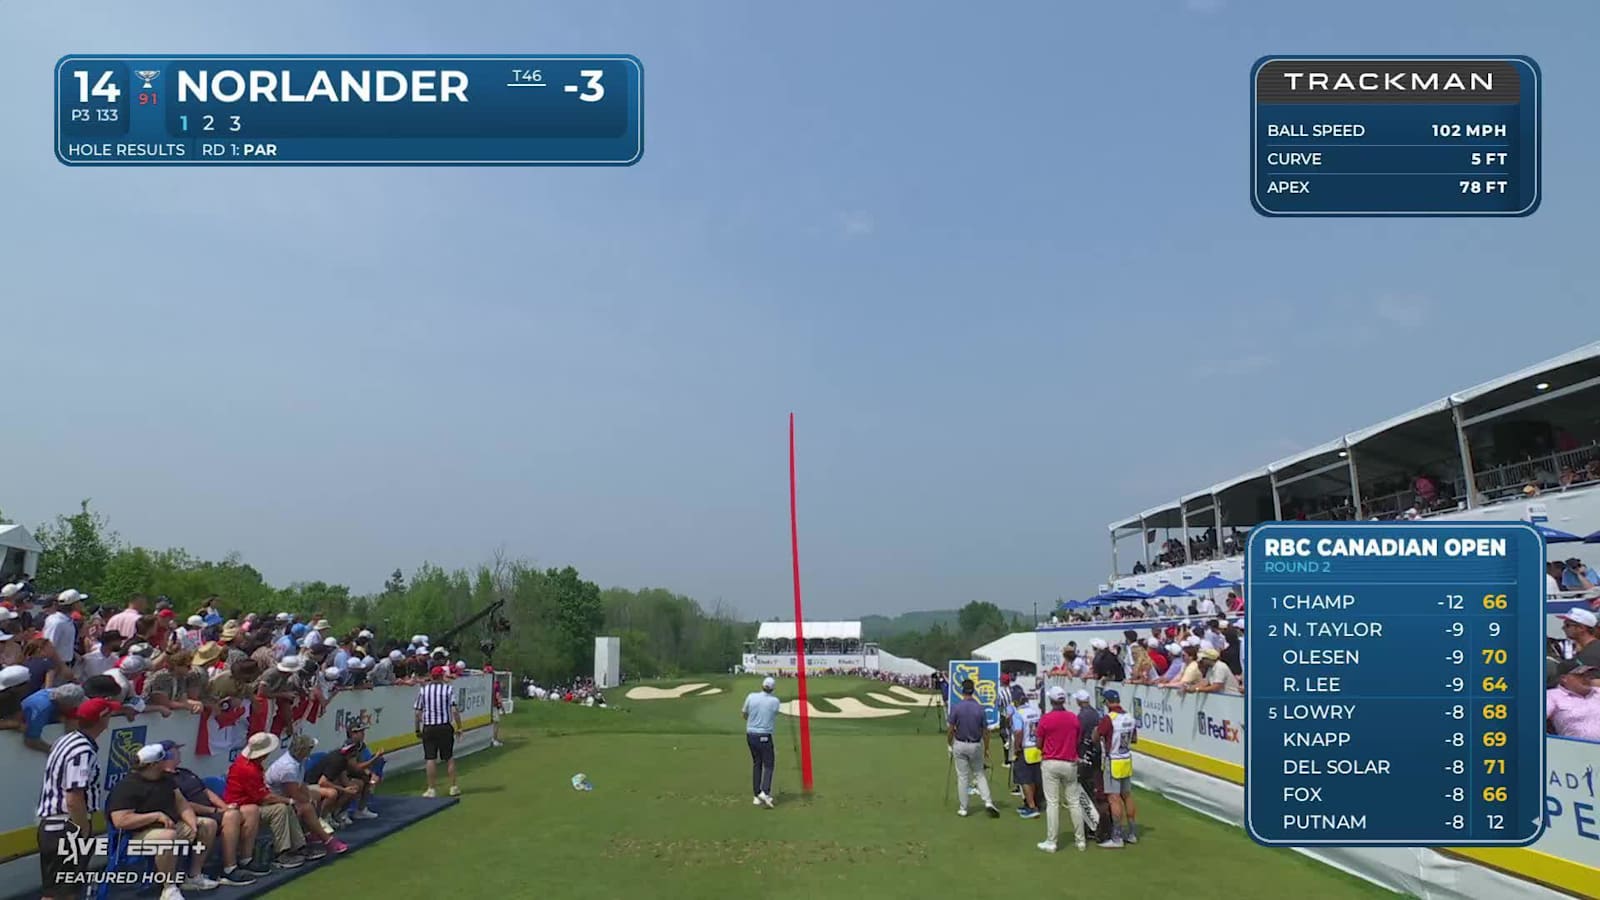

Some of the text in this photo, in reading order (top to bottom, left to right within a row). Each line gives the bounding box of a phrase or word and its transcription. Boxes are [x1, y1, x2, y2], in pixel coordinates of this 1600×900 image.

[466, 695, 486, 710] OPEN
[1144, 712, 1173, 734] OPEN
[1207, 716, 1240, 743] FedEx
[1546, 796, 1600, 841] PE
